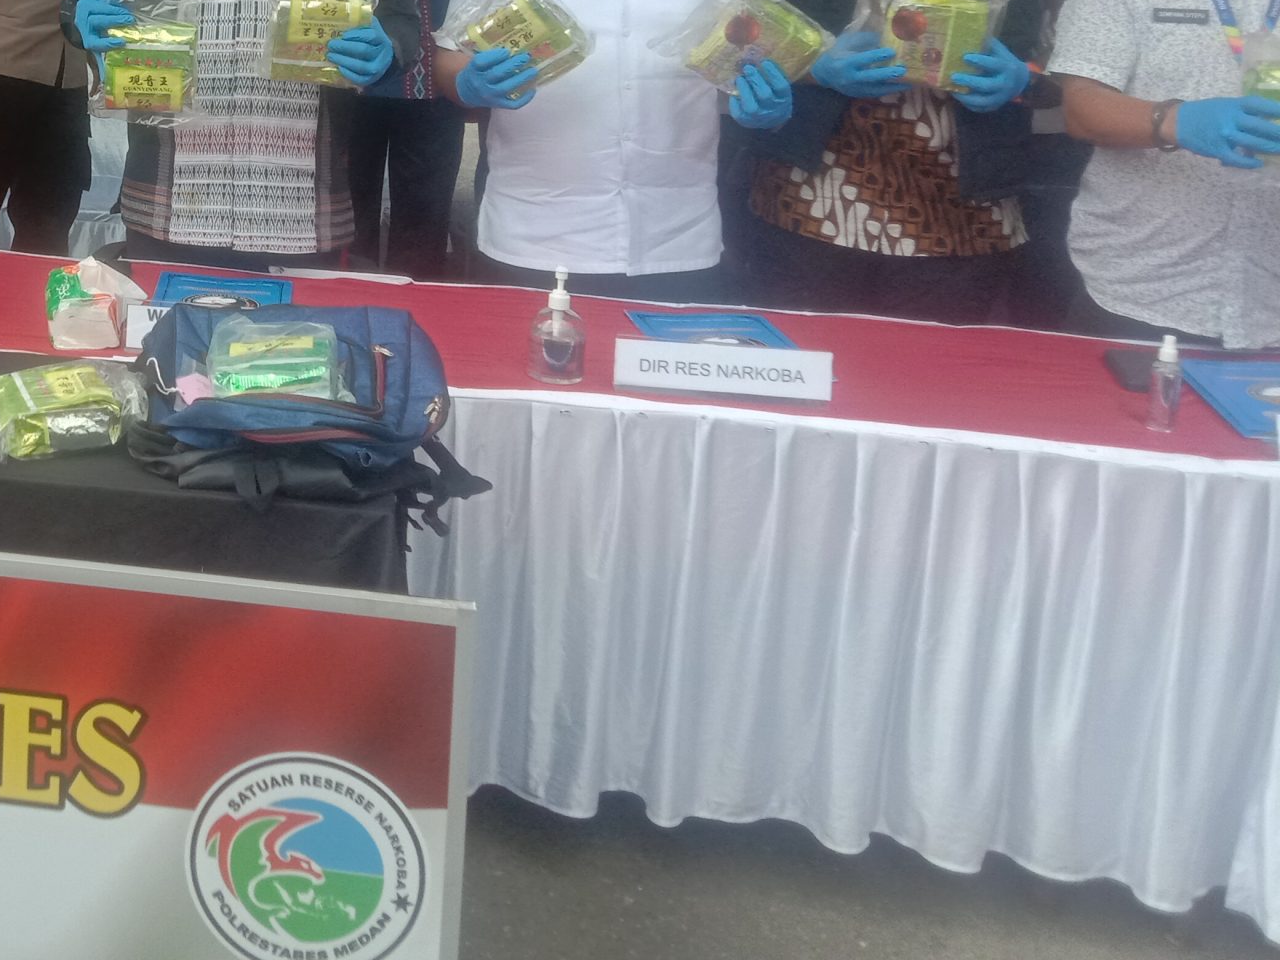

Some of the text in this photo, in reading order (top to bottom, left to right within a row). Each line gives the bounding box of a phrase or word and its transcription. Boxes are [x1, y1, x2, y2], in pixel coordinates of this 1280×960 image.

[639, 358, 806, 384] DIR RES NARKOBA
[227, 773, 408, 891] SATUAN RESERSE NARKOBA
[212, 889, 393, 960] POLRESTABES MEDAN
